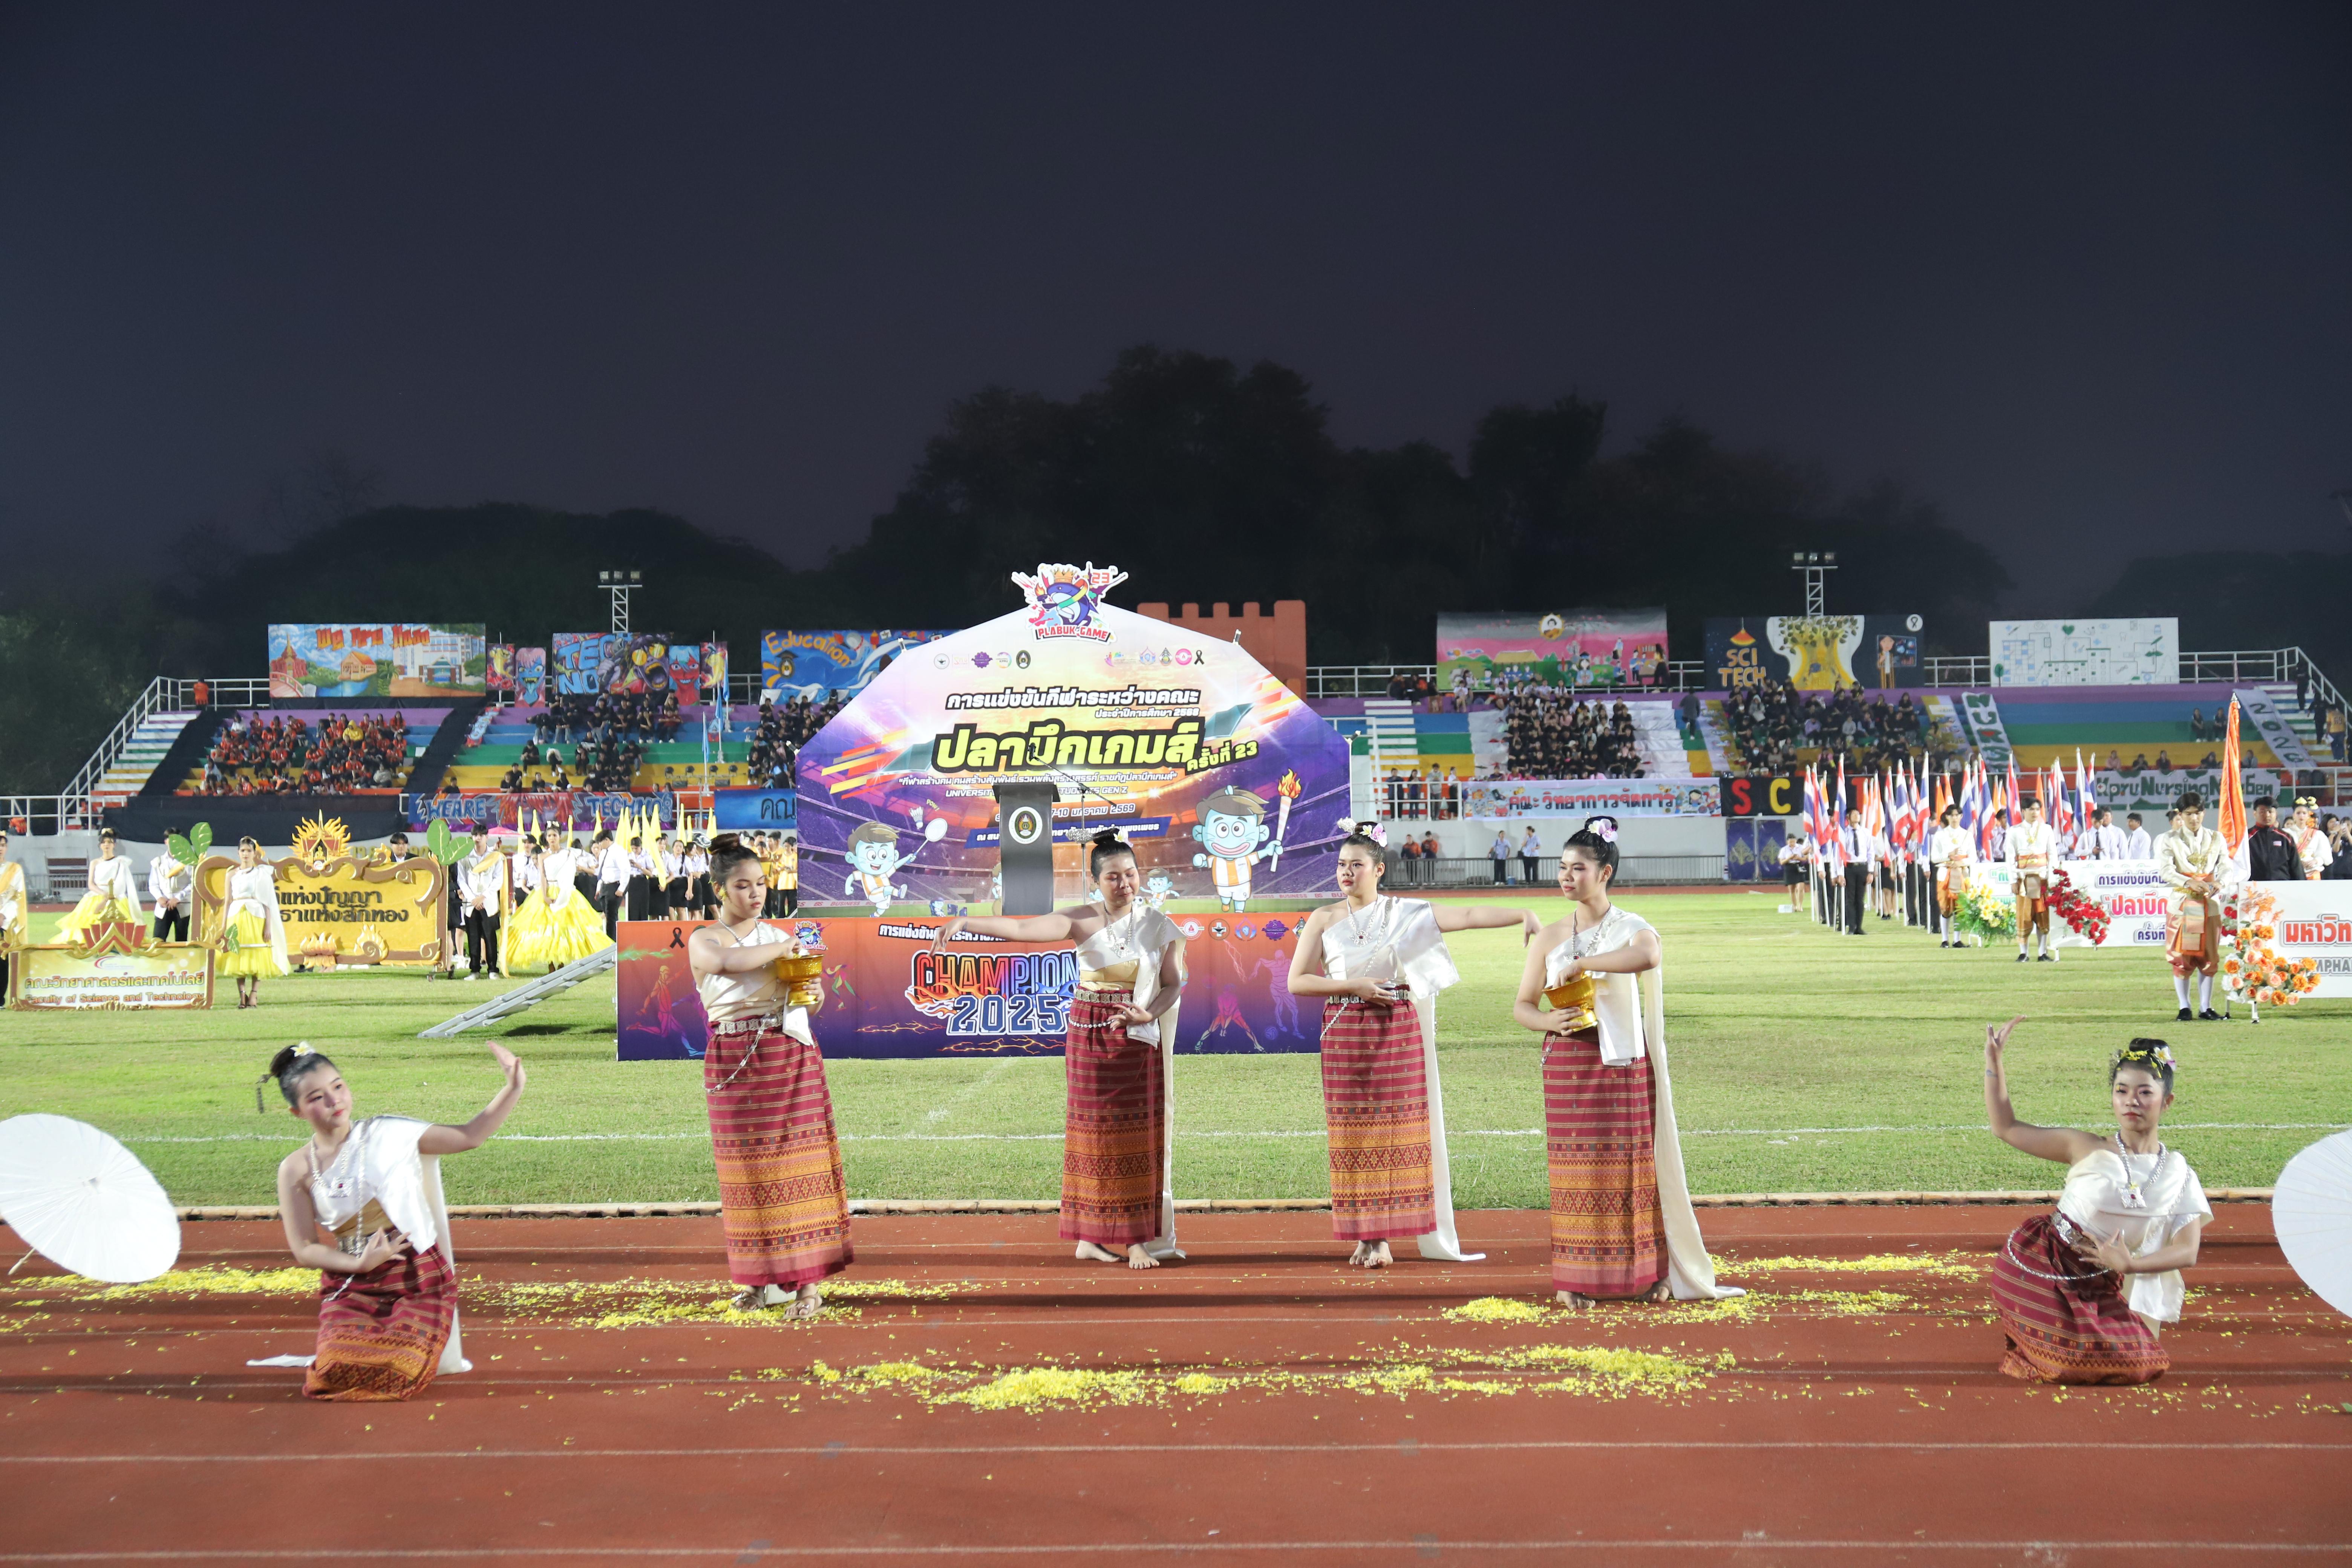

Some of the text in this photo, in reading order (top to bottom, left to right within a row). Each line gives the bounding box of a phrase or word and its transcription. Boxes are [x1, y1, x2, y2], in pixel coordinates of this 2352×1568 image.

[1092, 573, 1110, 584] 23
[1038, 626, 1109, 639] PLABUK GAME
[1726, 647, 1758, 667] SCI
[1718, 666, 1767, 688] TECH
[946, 685, 1200, 709] การแข่งขันกีฬาระหว่างคณะ
[1095, 708, 1200, 718] ประจำปีการศึกษา 2568
[936, 721, 1202, 768] ปลาบึกเกมส์
[1187, 741, 1258, 772] ครั้งที่ 23
[1111, 804, 1135, 814] 2569
[24, 972, 204, 989] คณะวิทยาศาสตร์และเทคโนโลยี
[25, 994, 62, 1005] Faculty
[65, 994, 76, 1003] of
[79, 993, 120, 1003] Science
[123, 992, 142, 1001] and
[948, 994, 1068, 1035] 2025
